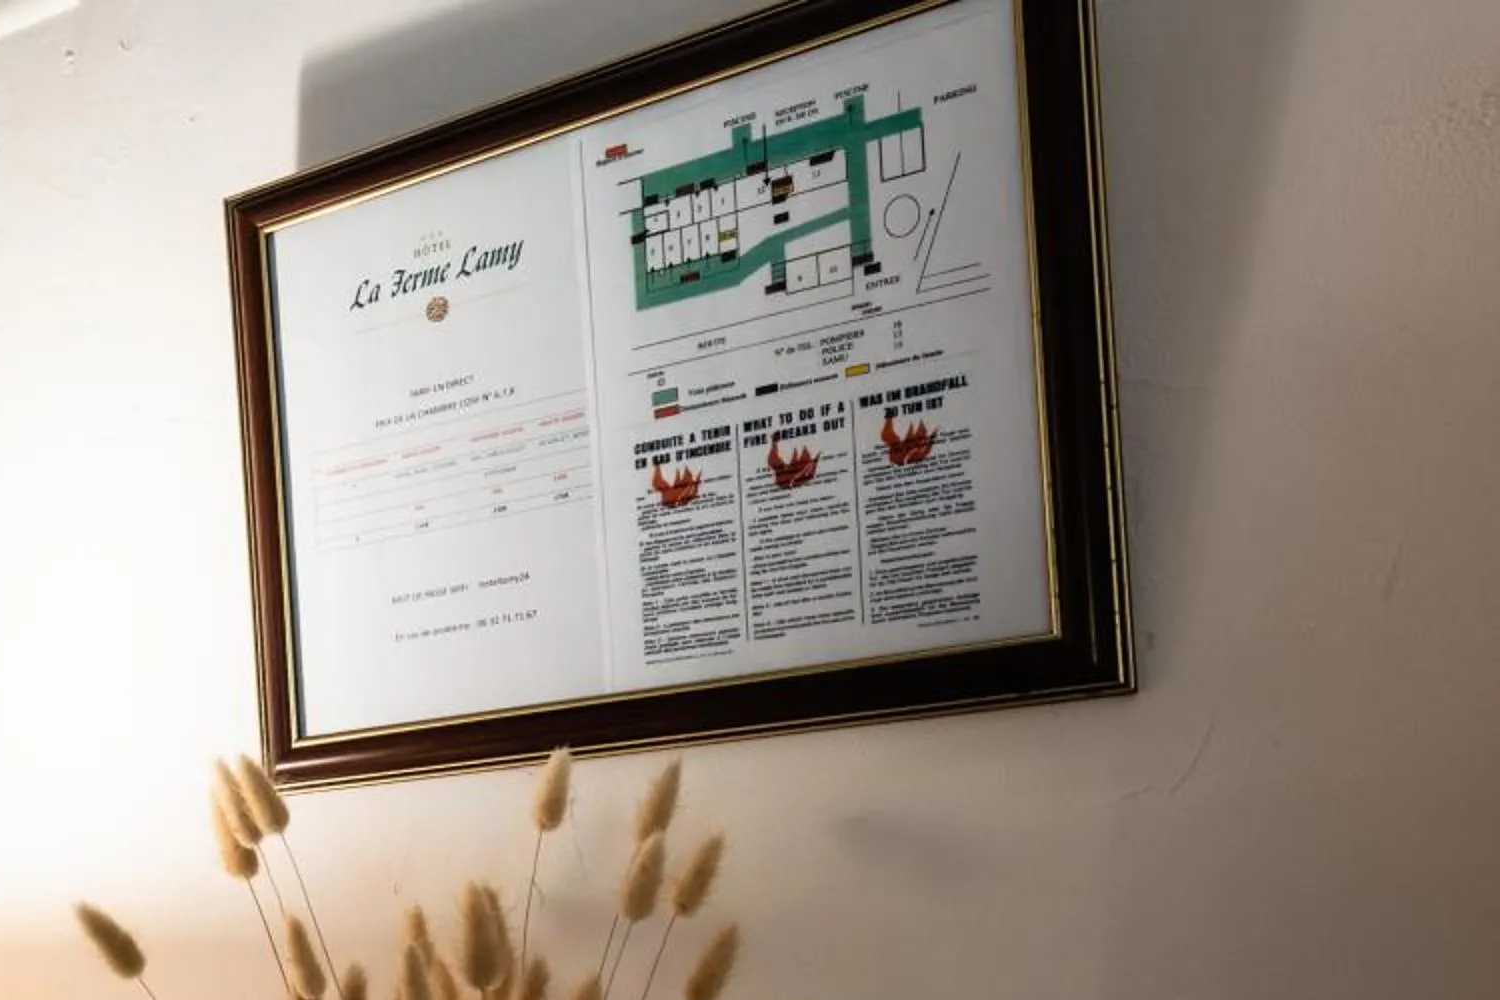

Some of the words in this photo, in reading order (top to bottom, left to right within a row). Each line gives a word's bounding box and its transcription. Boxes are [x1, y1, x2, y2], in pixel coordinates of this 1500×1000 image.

[933, 84, 978, 105] PARKING
[350, 279, 381, 311] La
[391, 261, 451, 298] Ferme
[456, 239, 525, 279] Lamy
[820, 329, 865, 346] POMPIERS
[821, 342, 854, 356] POLICE
[822, 353, 849, 367] SAMU
[445, 374, 475, 391] DIRECT
[859, 392, 883, 409] WAS
[885, 388, 901, 402] IM
[904, 374, 969, 398] BRANDFALL
[743, 415, 773, 433] WHAT
[779, 411, 794, 426] TO
[799, 406, 816, 422] DO
[820, 403, 831, 417] IF
[837, 400, 845, 413] A
[901, 400, 922, 416] TUN
[925, 396, 945, 411] IST
[633, 434, 684, 456] CONDUITE
[689, 431, 697, 444] A
[701, 425, 732, 442] TENIR
[743, 433, 768, 448] FIRE
[771, 423, 817, 443] BREAKS
[823, 417, 846, 432] OUT
[634, 457, 648, 470] EN
[651, 452, 672, 467] CAS
[675, 439, 732, 462] D'INCENDIE
